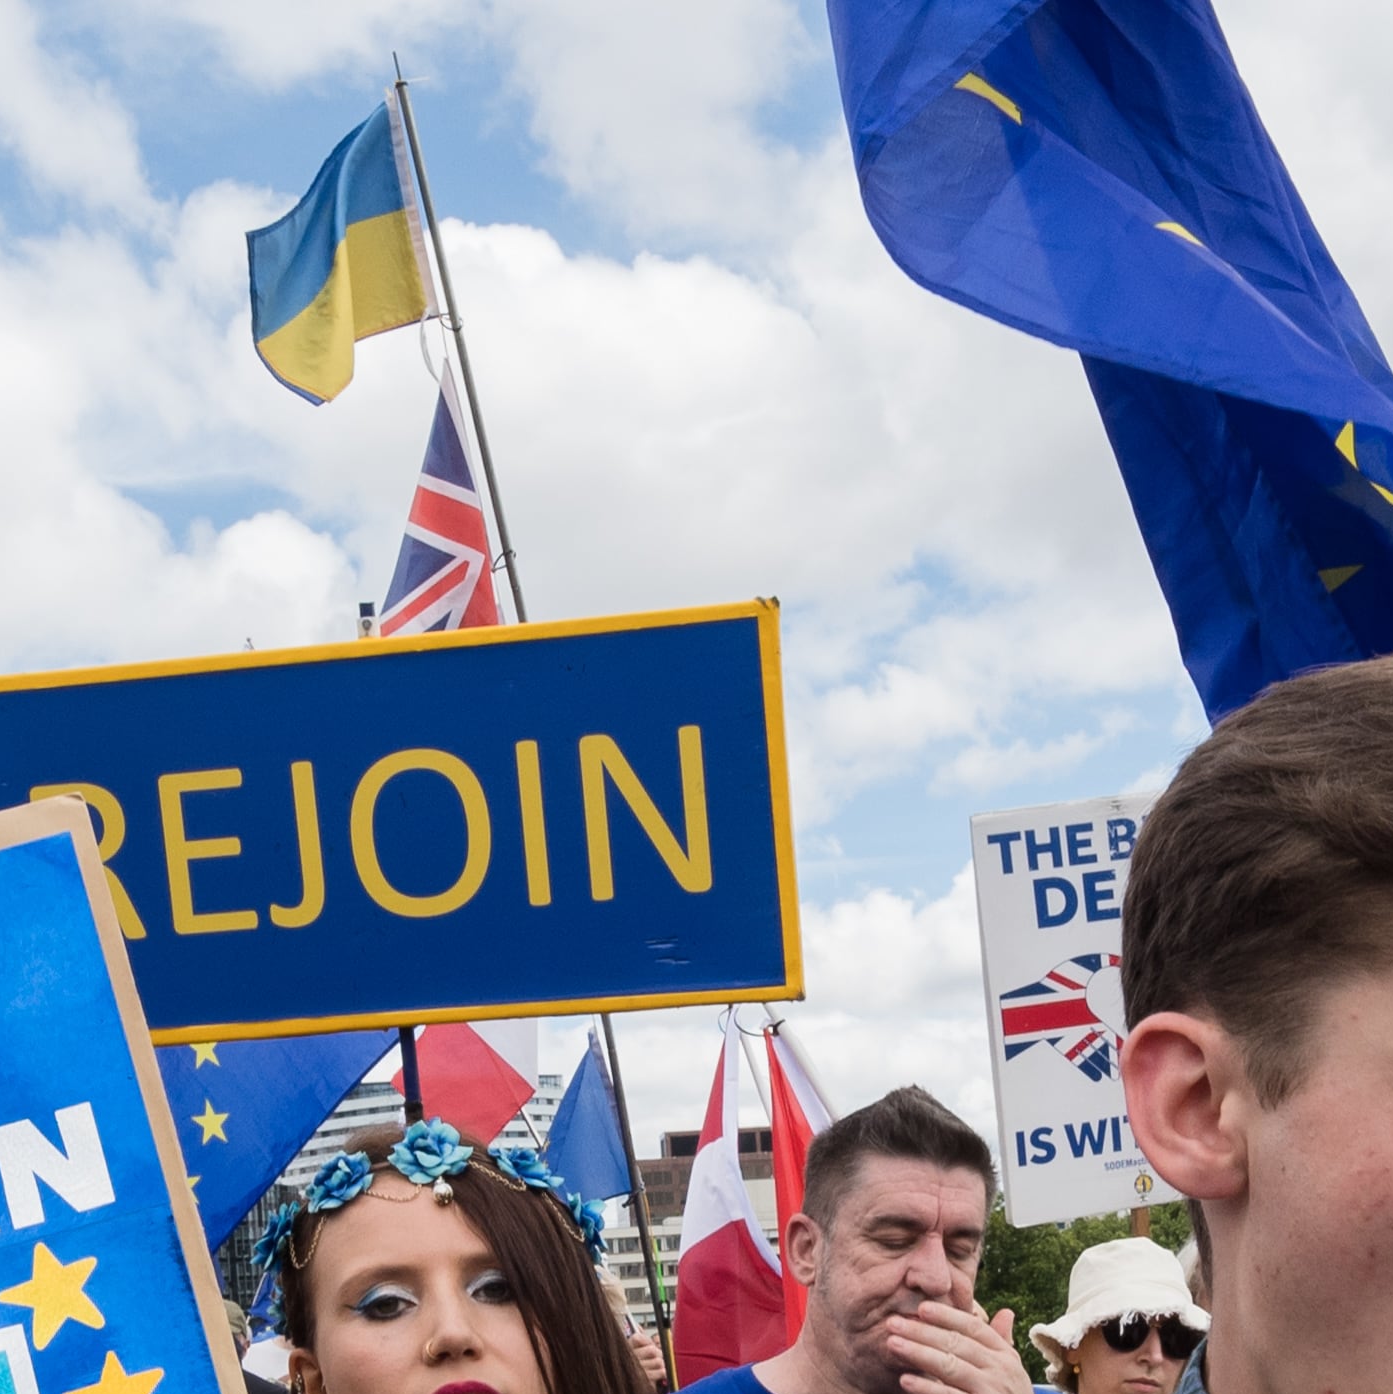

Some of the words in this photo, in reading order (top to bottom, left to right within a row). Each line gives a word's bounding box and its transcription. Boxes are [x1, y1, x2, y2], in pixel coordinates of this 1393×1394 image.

[987, 822, 1098, 874] THE
[1032, 869, 1121, 929] DE
[1016, 1126, 1056, 1167] IS
[1064, 1115, 1139, 1158] WI
